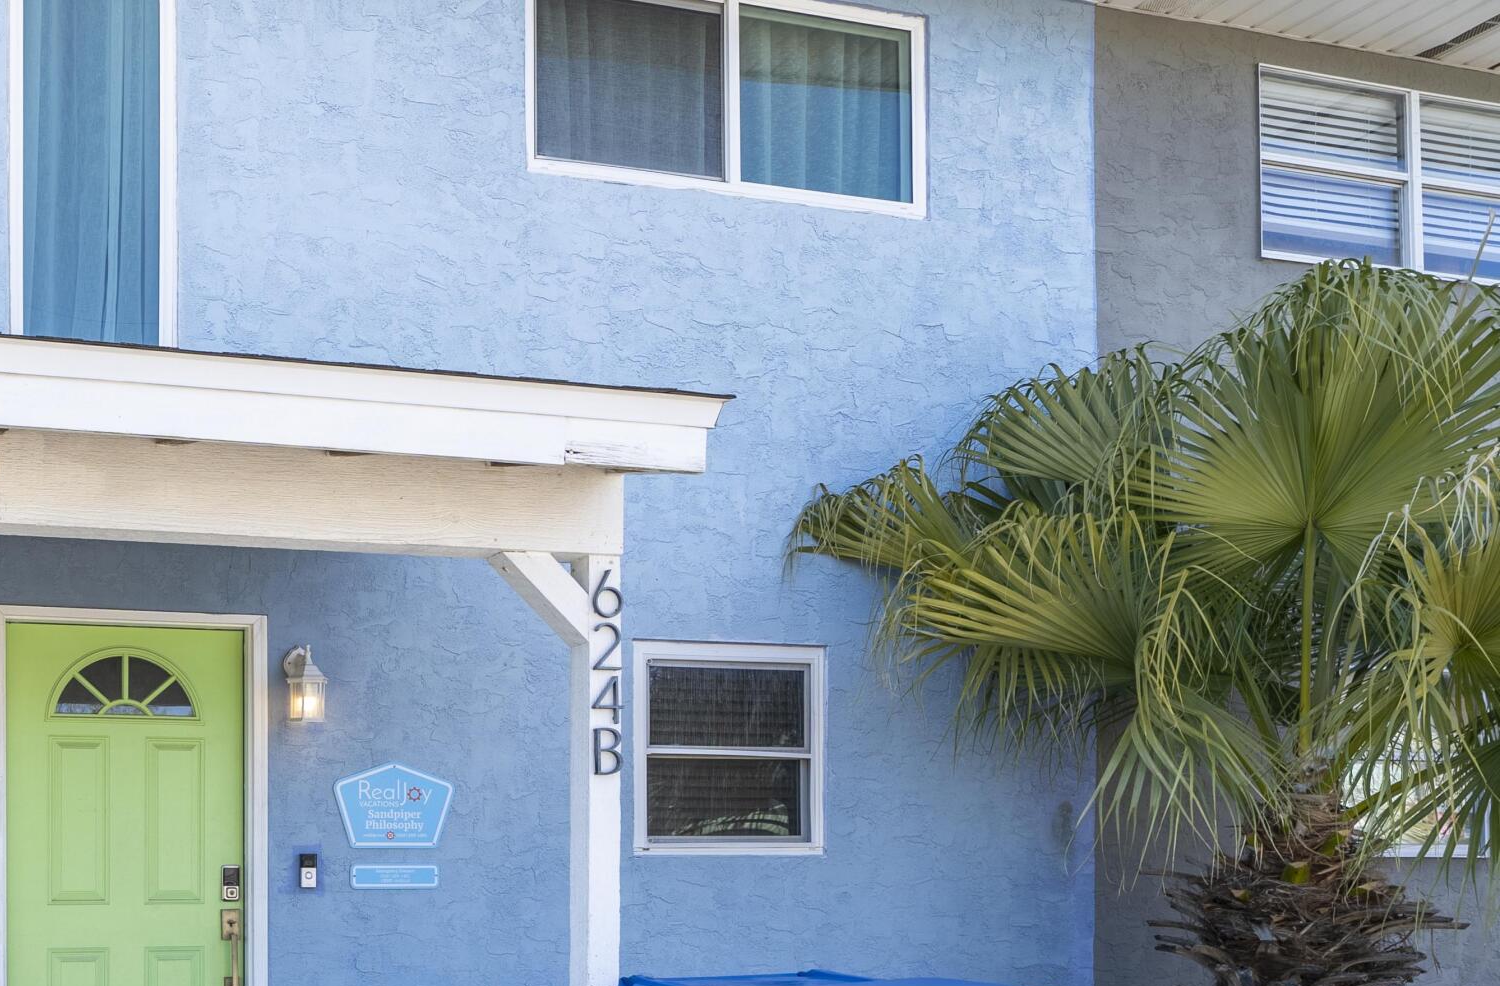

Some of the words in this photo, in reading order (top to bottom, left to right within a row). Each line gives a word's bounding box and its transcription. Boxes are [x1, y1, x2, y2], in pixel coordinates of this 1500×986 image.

[591, 569, 624, 775] 624B
[367, 809, 422, 820] Sandpiper
[365, 819, 425, 832] Philosophy
